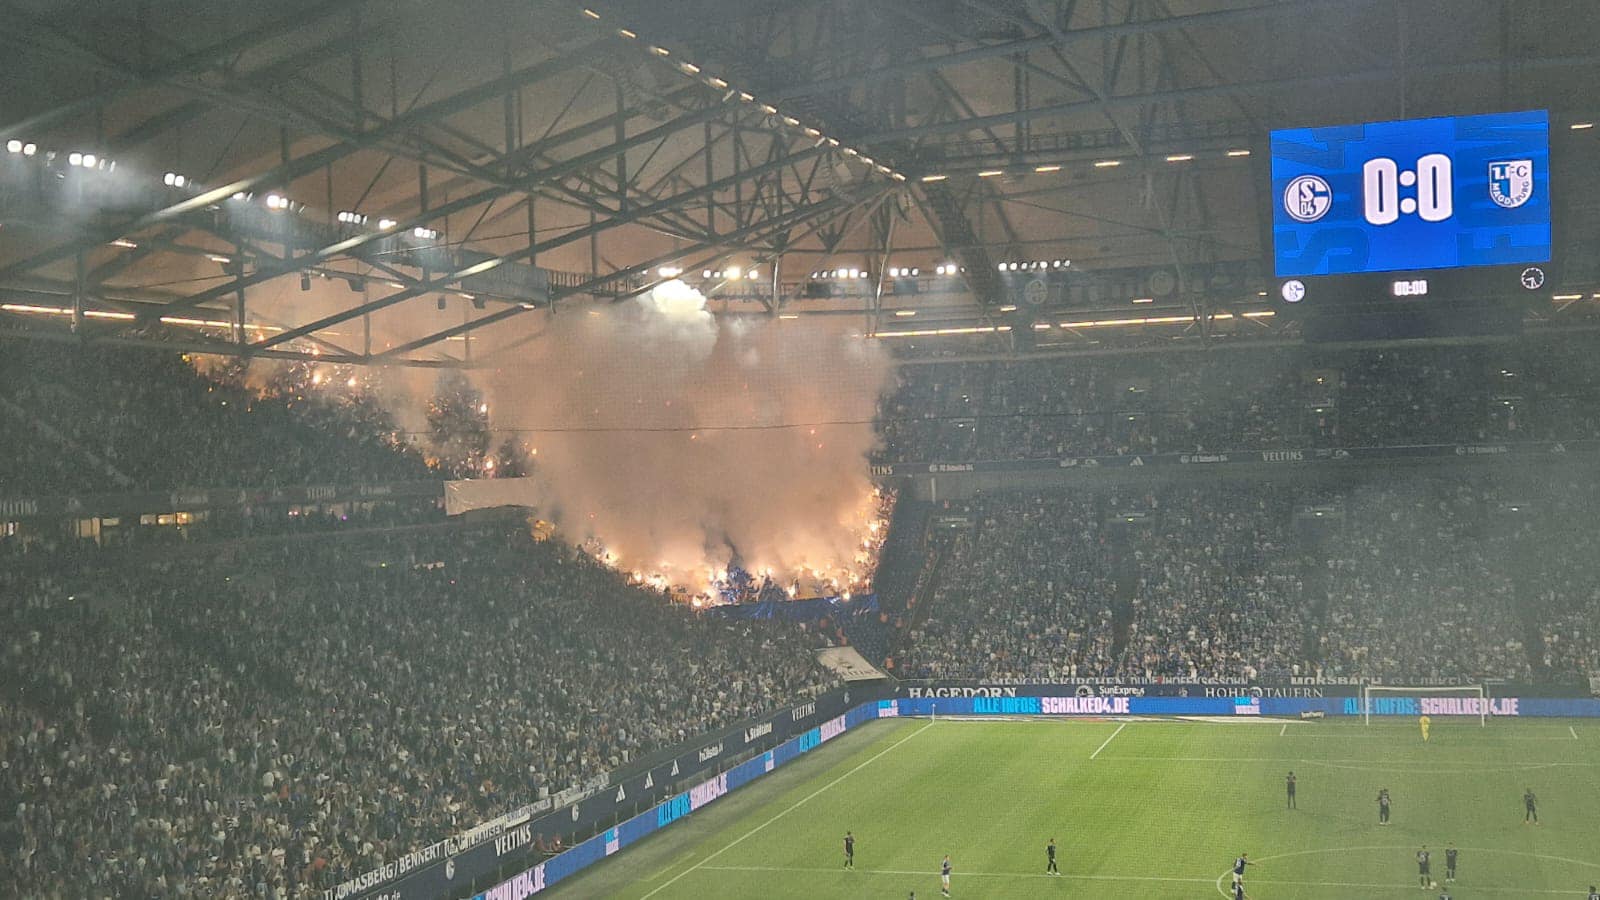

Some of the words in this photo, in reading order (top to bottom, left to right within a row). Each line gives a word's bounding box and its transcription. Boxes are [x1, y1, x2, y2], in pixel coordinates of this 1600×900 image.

[1364, 153, 1452, 225] 0:0
[1262, 451, 1303, 461] VELTINS
[1290, 676, 1382, 686] MORSBACH
[908, 687, 1016, 699] HAGEDORN
[1099, 685, 1145, 697] SunExpress
[1205, 687, 1249, 698] HOHE
[1265, 687, 1323, 698] TAUERN
[791, 702, 816, 721] VELTINS
[974, 697, 1000, 713] ALLE
[1002, 697, 1041, 713] INFOS:
[1042, 697, 1130, 713] SCHALKE04.DE
[1421, 697, 1519, 715] SCHALKE04.DE
[495, 825, 531, 857] VELTINS
